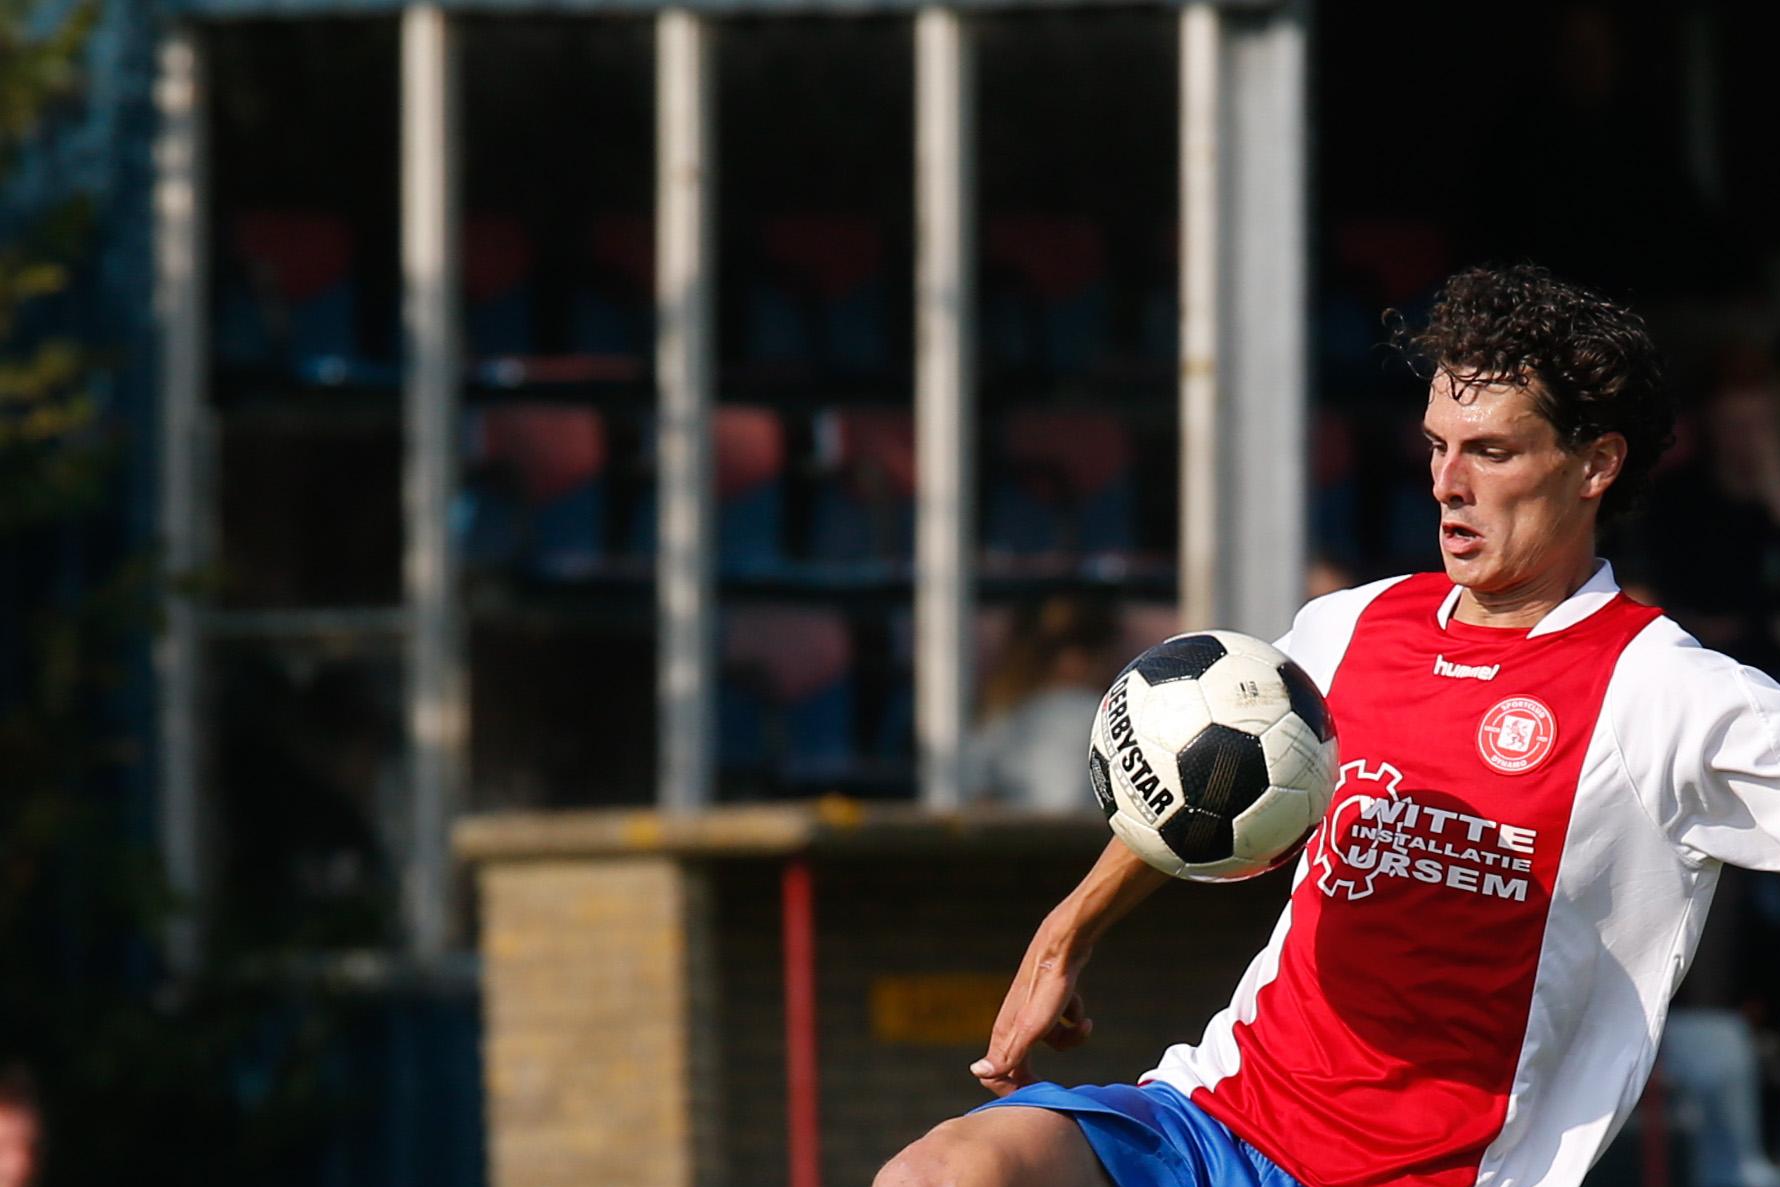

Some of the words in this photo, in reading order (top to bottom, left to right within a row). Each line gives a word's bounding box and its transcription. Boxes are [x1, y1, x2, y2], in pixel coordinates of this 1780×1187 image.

[1433, 654, 1500, 681] hummel
[1108, 676, 1174, 816] DERBYSTAR
[1351, 825, 1532, 873] INSTALLATIE
[1359, 797, 1537, 854] WITTE
[1348, 845, 1529, 902] URSEM
